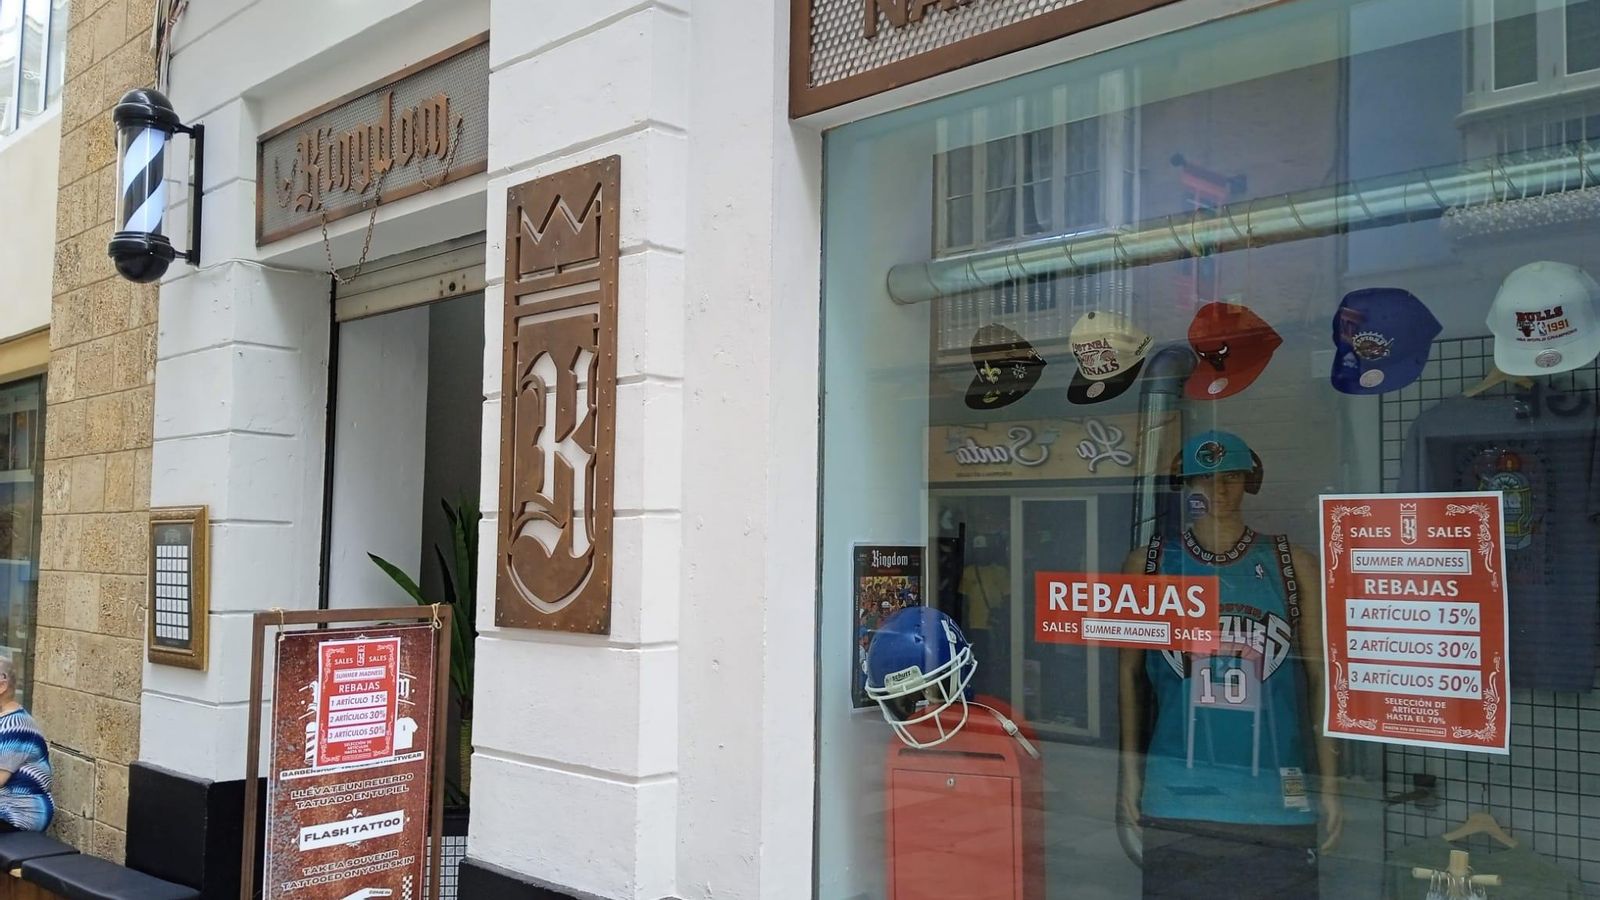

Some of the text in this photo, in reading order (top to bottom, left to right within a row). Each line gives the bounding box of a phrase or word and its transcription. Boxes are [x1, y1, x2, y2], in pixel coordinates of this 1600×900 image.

[295, 91, 450, 212] Kingdom
[1515, 306, 1564, 322] BULLS
[1547, 319, 1569, 332] 1991
[1350, 526, 1391, 538] SALES
[1427, 526, 1472, 538] SALES
[871, 550, 909, 569] Kingdom
[1355, 556, 1464, 568] SUMMER MADNESS
[1364, 578, 1459, 597] REBAJAS
[1049, 581, 1206, 618] REBAJAS
[1350, 605, 1477, 625] 1 ARTÍCULO 15%
[1042, 621, 1078, 633] SALES
[1085, 624, 1166, 638] SUMMER MADNESS
[1174, 628, 1212, 642] SALES
[1349, 637, 1478, 660] 2 ARTÍCULOS 30%
[334, 657, 353, 666] SALES
[369, 654, 387, 663] SALES
[336, 669, 384, 680] SUMMER MADNESS
[1351, 669, 1479, 694] 3 ARTÍCULOS 50%
[338, 680, 381, 694] REBAJAS
[1201, 668, 1247, 704] 10
[336, 696, 368, 706] ARTÍCULO
[371, 693, 386, 704] 15%
[1384, 697, 1447, 709] SELECCIÓN DE
[335, 712, 369, 723] ARTÍCULOS
[369, 709, 385, 720] 30%
[1392, 704, 1439, 716] ARTÍCULOS
[1386, 713, 1446, 725] HASTA EL 70%
[334, 728, 368, 739] ARTÍCULOS
[368, 725, 385, 736] 50%
[291, 783, 345, 799] LLÉVATE
[346, 781, 363, 791] UN
[296, 784, 410, 810] TATUADO EN TU PIEL
[304, 817, 400, 842] FLASH TATTOO
[303, 849, 400, 876] TAKE A SOUVENIR
[281, 855, 416, 891] TATTOOED ON YOUR SKIN
